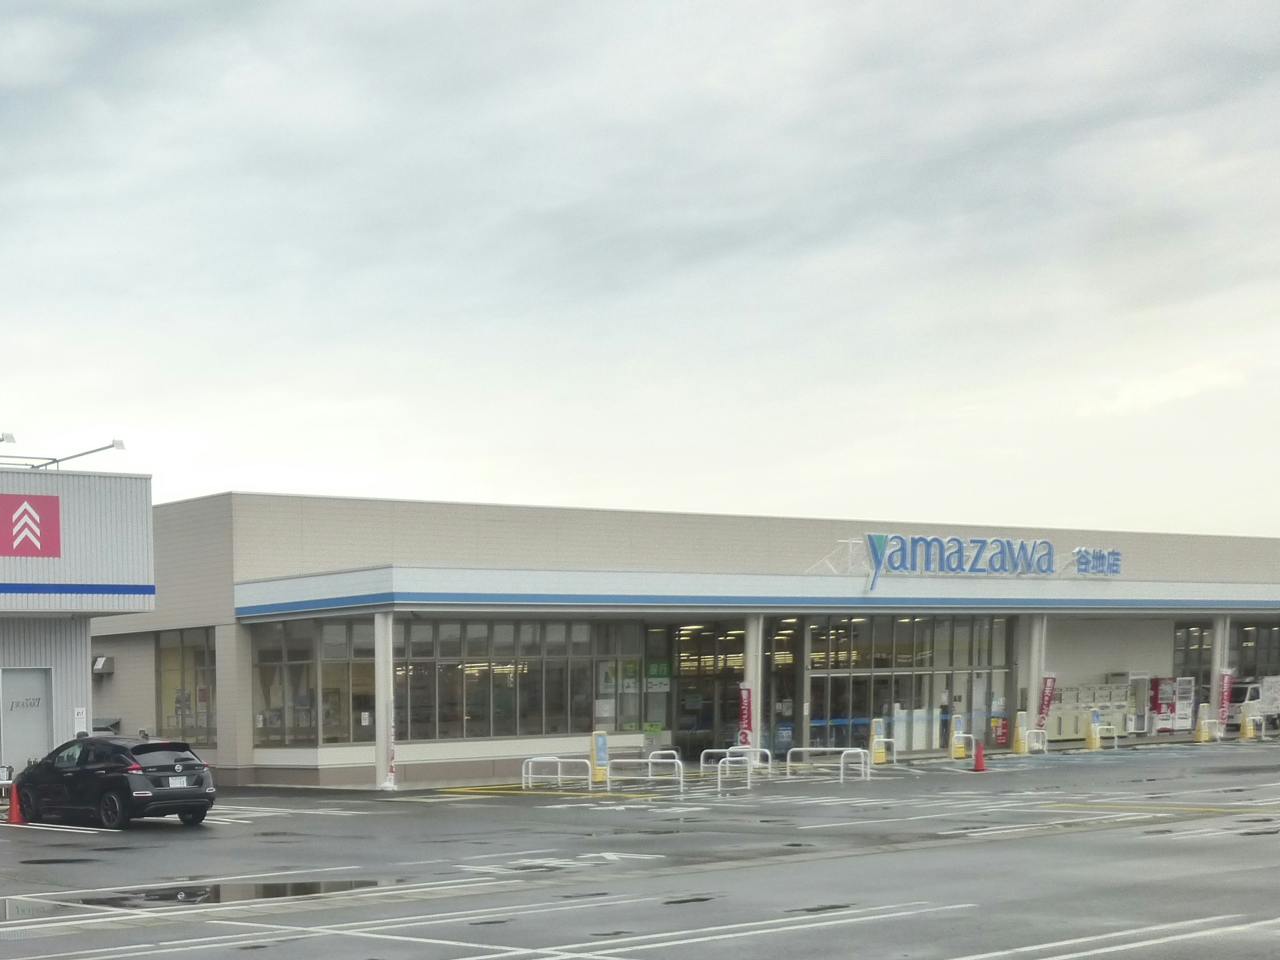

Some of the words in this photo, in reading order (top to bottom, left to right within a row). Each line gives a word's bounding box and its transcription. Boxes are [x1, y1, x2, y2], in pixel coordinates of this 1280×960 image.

[867, 534, 1055, 591] yamazawa
[1075, 550, 1121, 576] 谷地店
